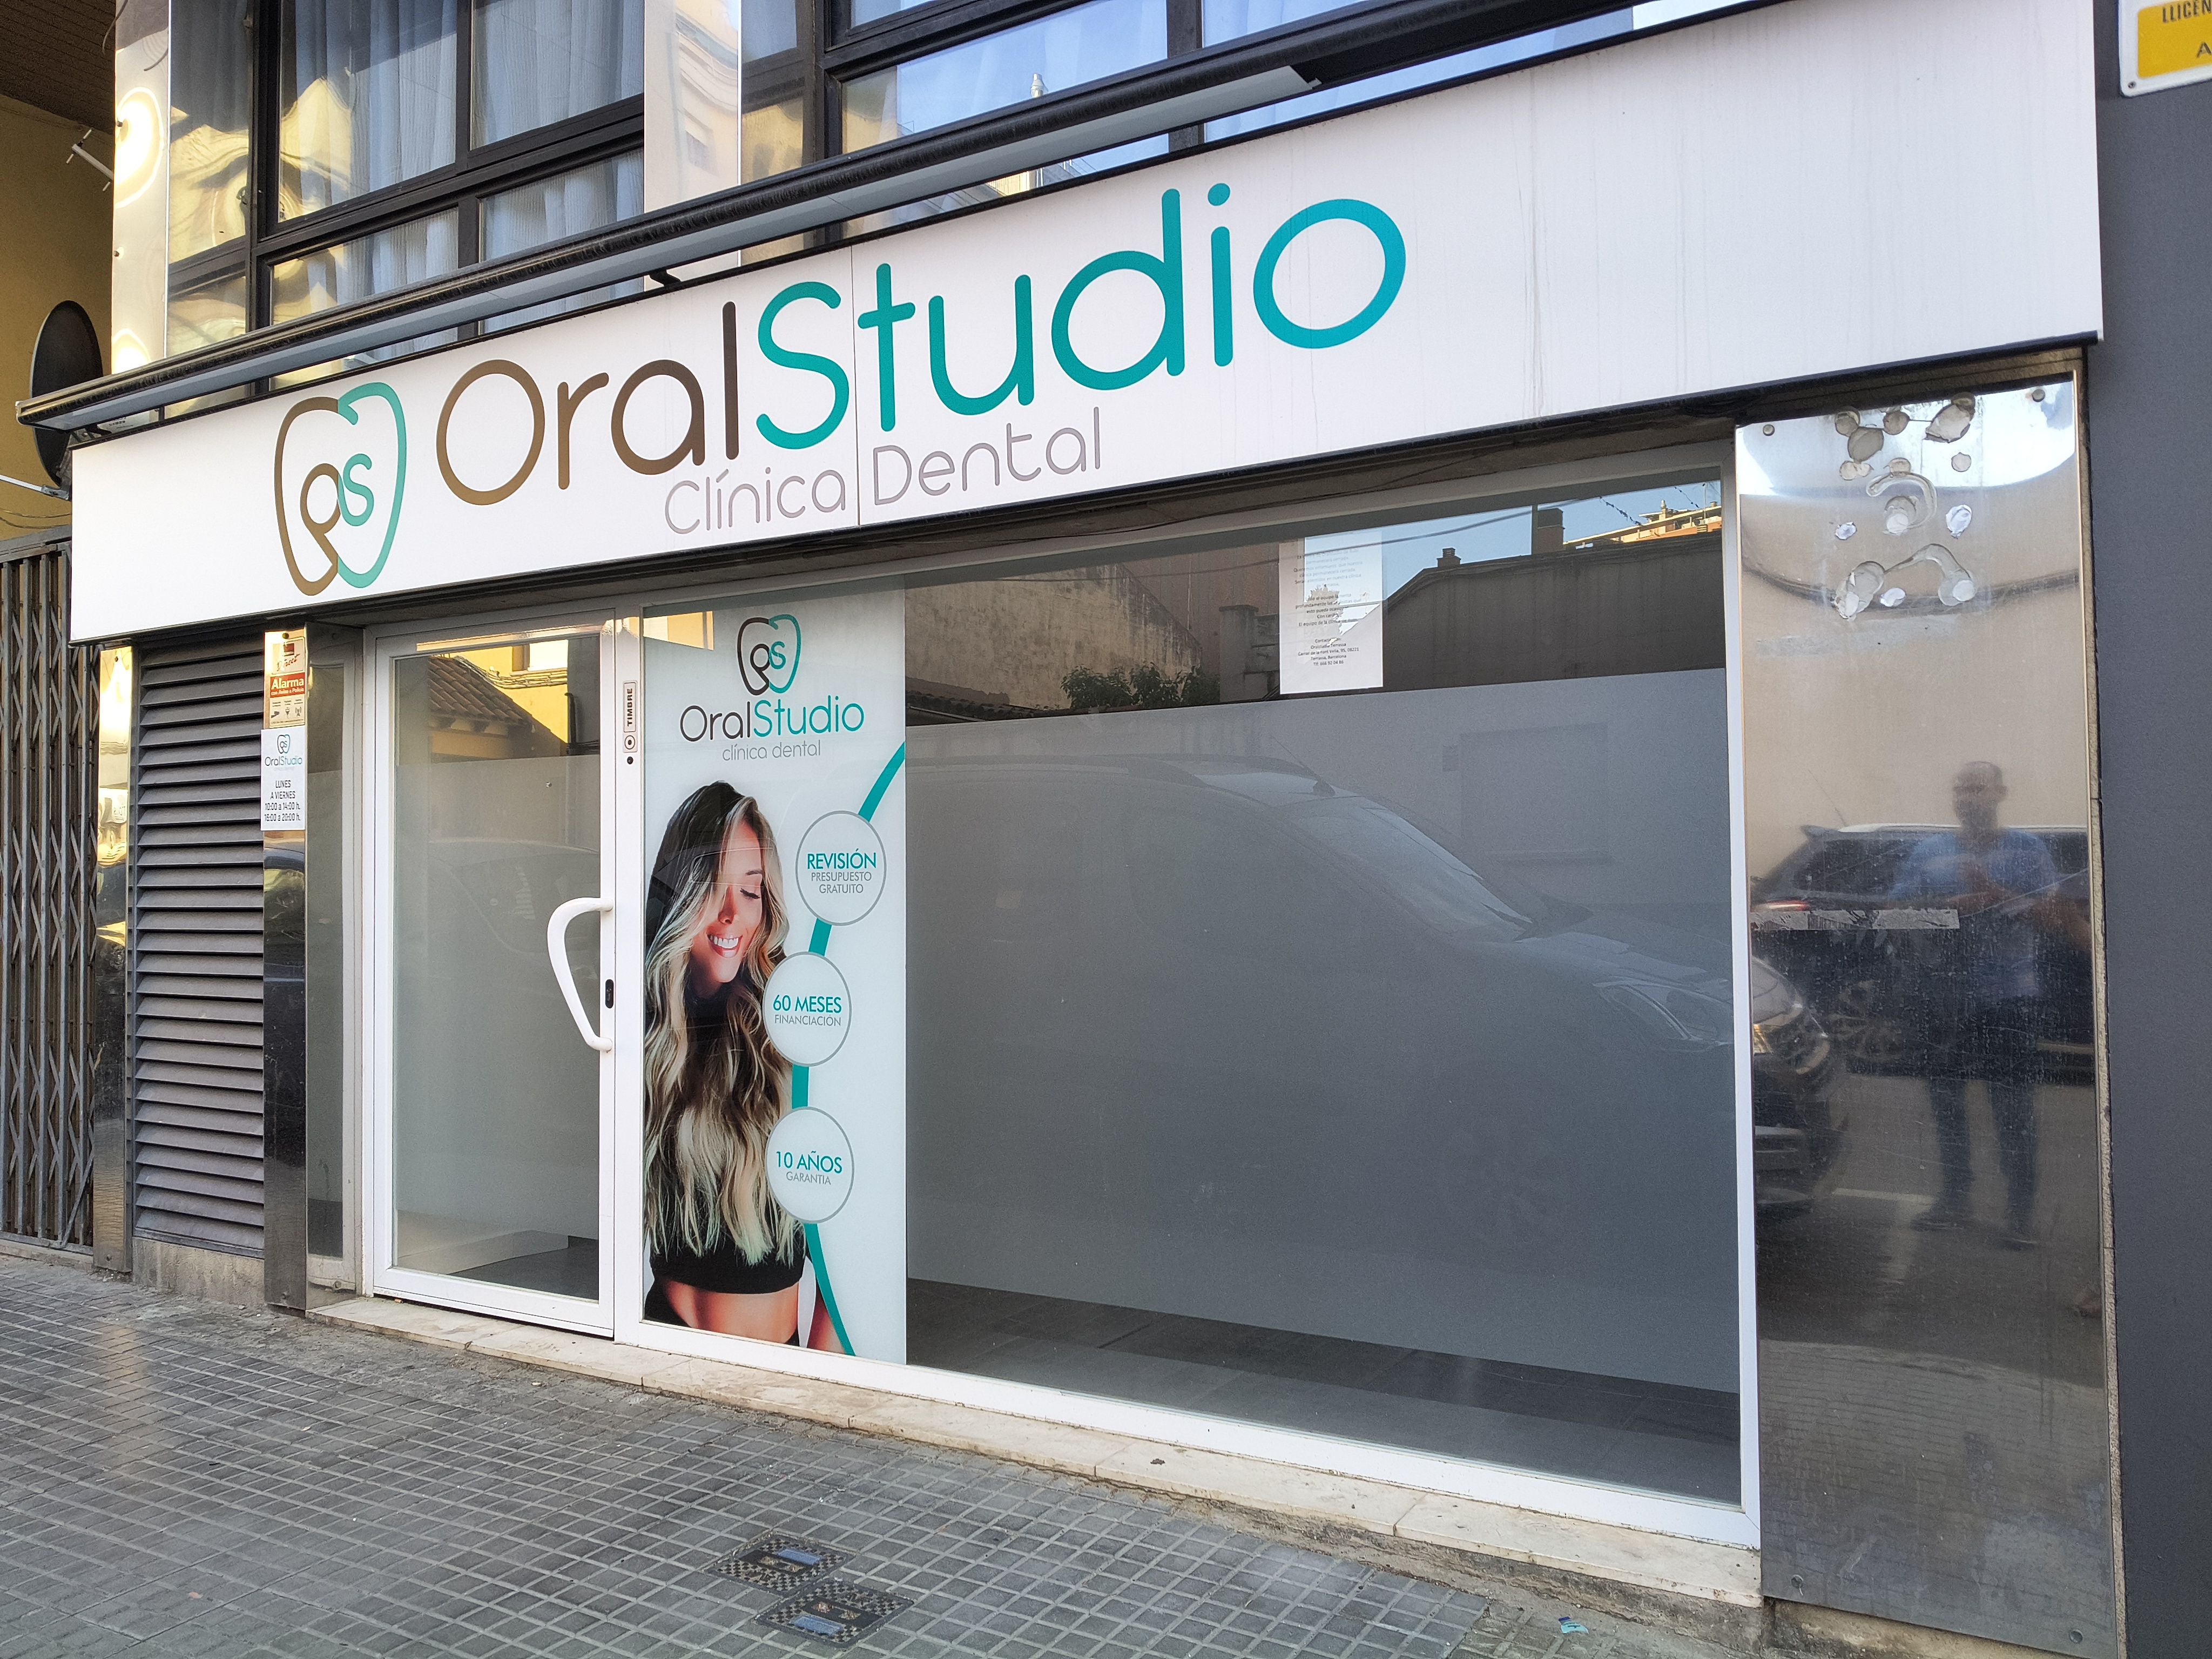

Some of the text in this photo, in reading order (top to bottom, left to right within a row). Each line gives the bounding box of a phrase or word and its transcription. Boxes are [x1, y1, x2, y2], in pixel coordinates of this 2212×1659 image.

[436, 183, 1406, 505] OralStudio
[665, 407, 1101, 535] Clínica Dental
[271, 677, 304, 690] Alarma
[680, 695, 864, 741] OralStudio
[723, 739, 821, 761] clínica dental
[265, 756, 303, 766] OralStudio
[275, 780, 291, 788] LUNES
[275, 791, 295, 799] VIERNES
[807, 848, 876, 869] REVISIÓN
[811, 872, 872, 881] PRESUPUESTO
[819, 884, 864, 894] GRATUITO
[773, 995, 842, 1013] 60 MESES
[774, 1014, 841, 1026] FINANCIACIÓN
[776, 1150, 842, 1174] 10 AÑOS
[786, 1171, 831, 1185] GARANTIA
